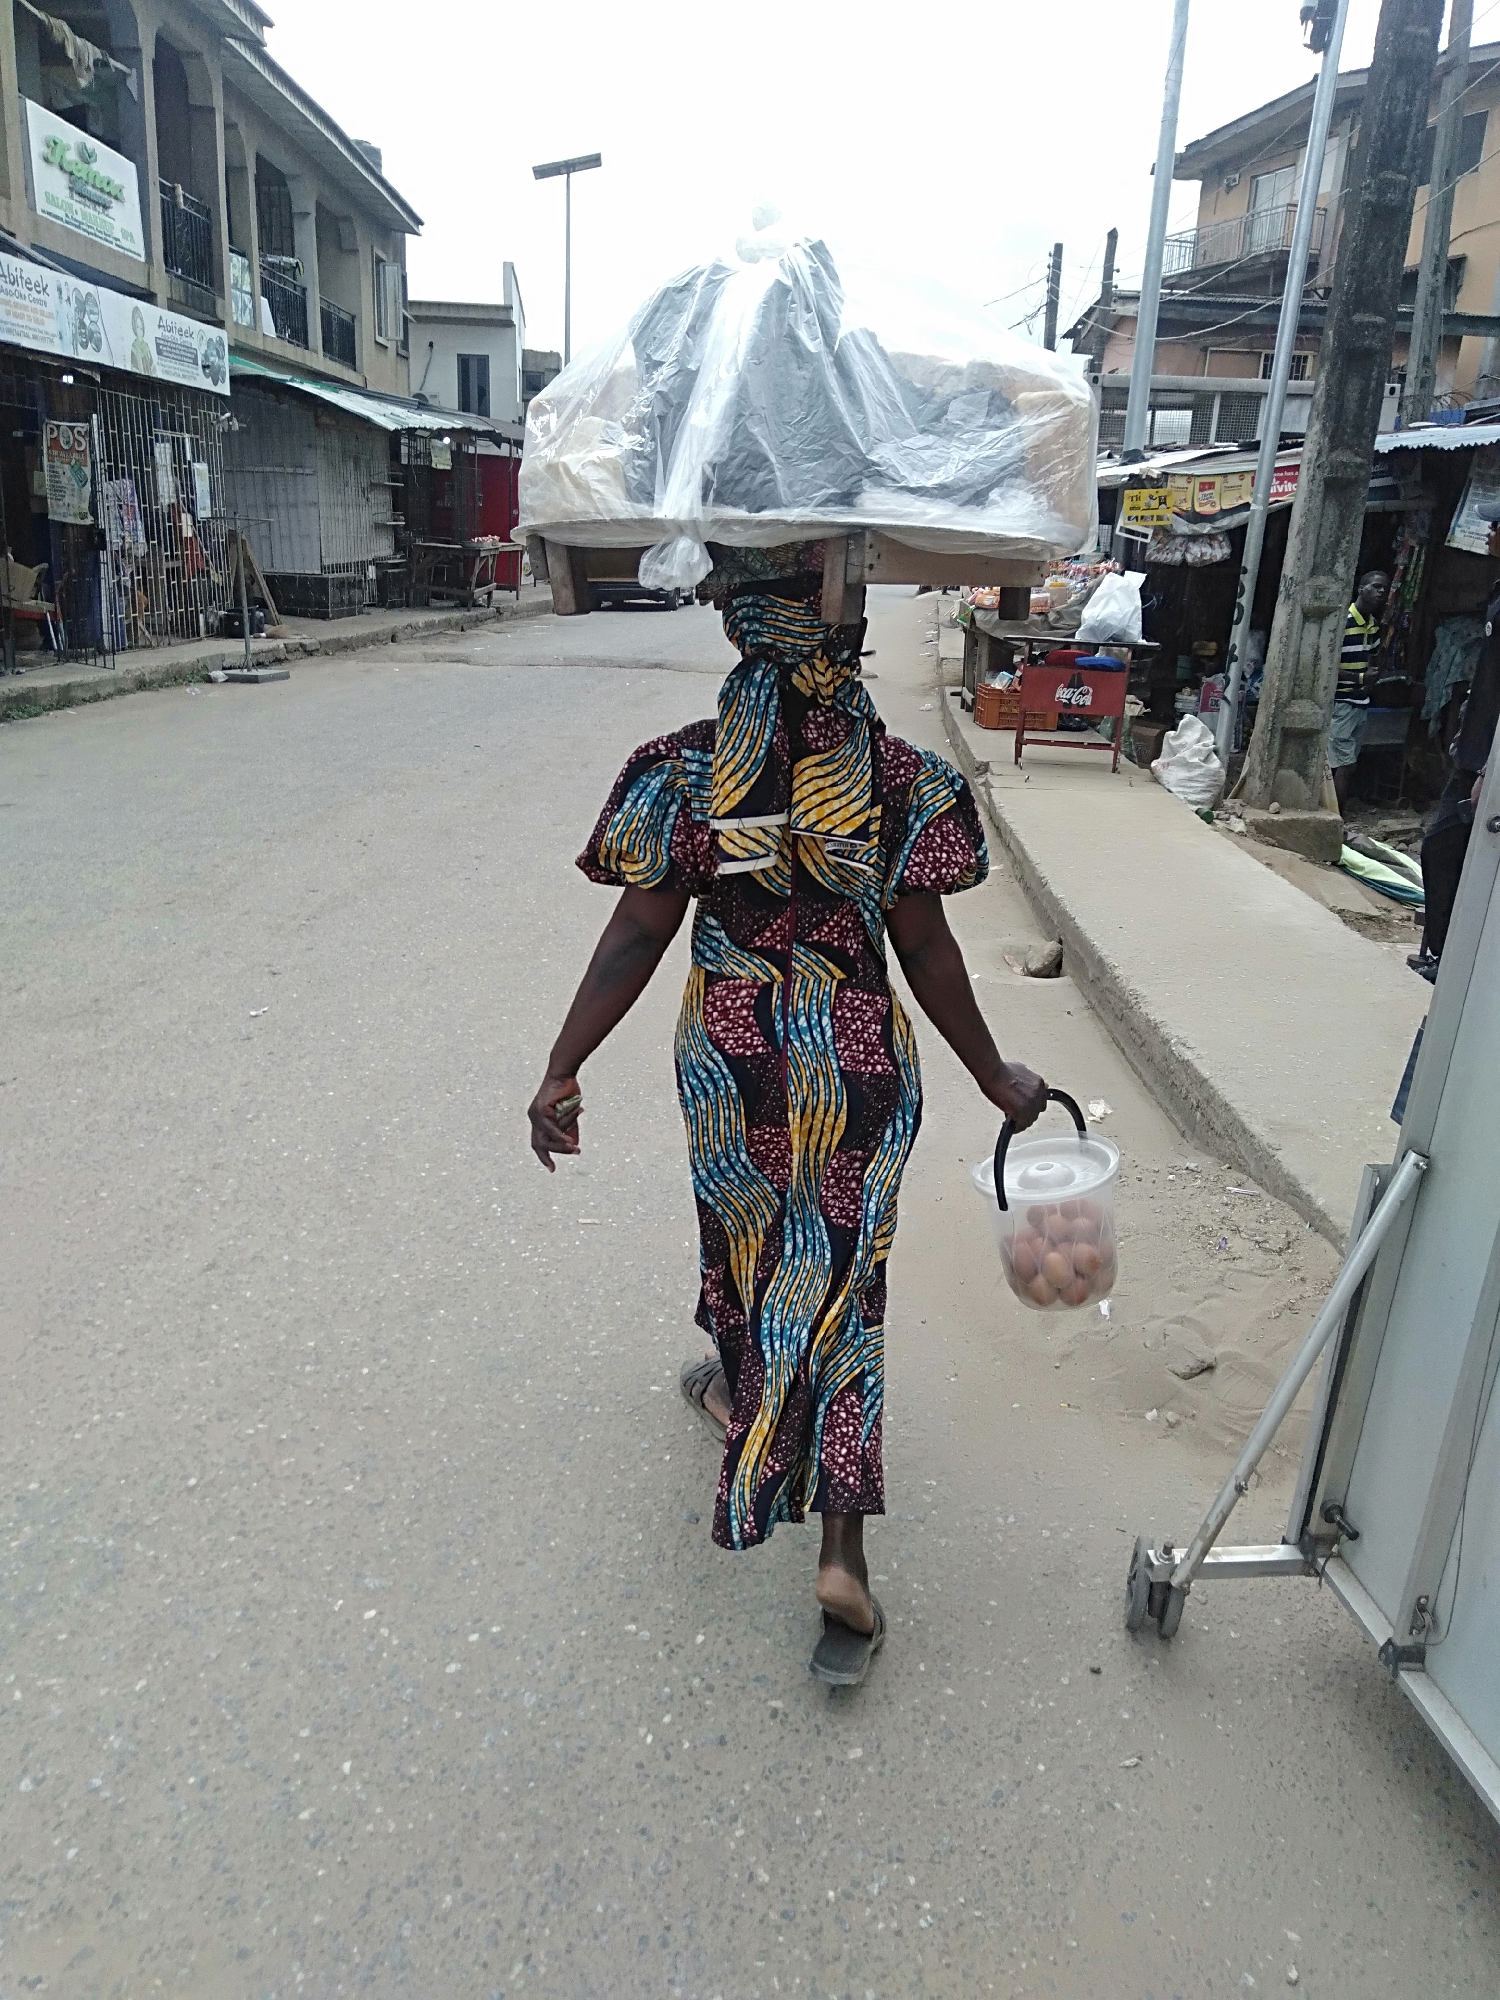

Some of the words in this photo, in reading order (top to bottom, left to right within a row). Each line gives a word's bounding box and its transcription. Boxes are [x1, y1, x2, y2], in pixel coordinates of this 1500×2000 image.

[120, 227, 136, 244] SPA
[27, 293, 48, 308] Centre
[157, 315, 195, 340] Abifeek
[46, 424, 87, 452] POS
